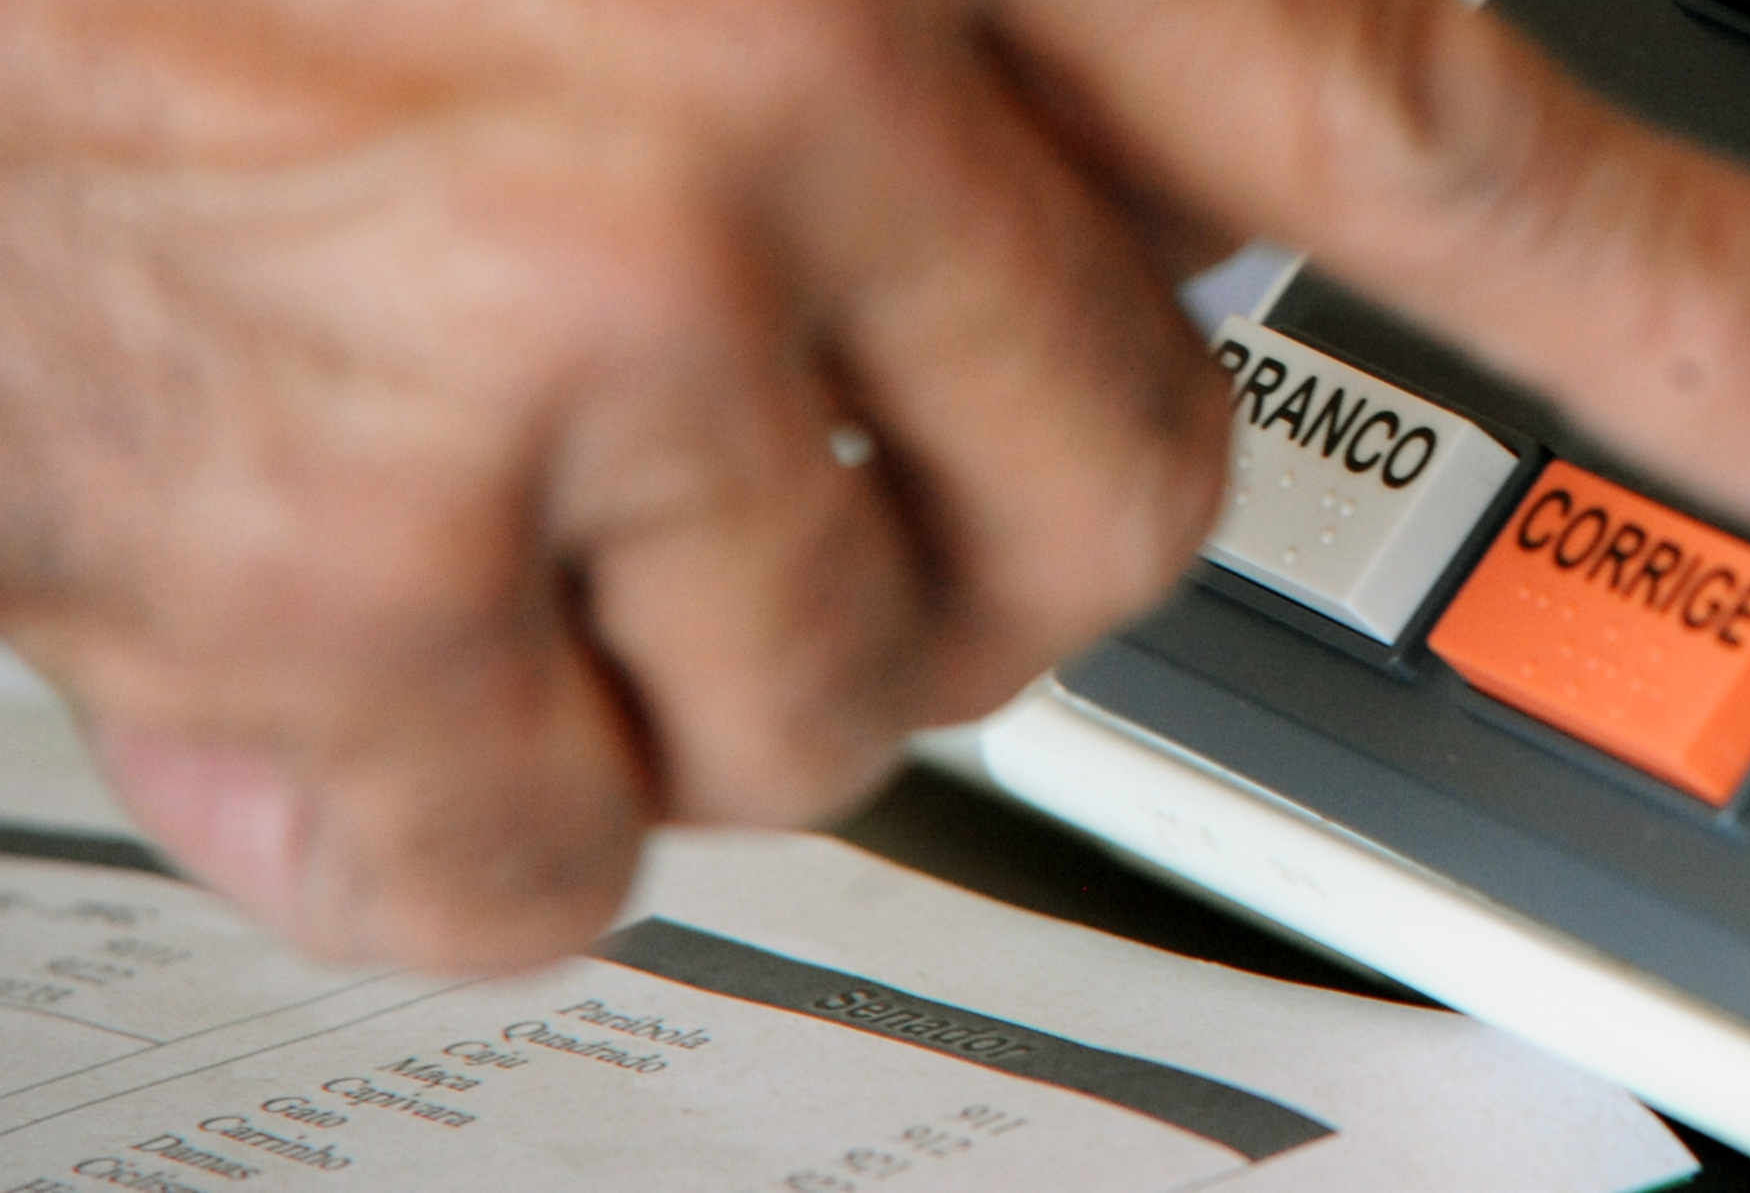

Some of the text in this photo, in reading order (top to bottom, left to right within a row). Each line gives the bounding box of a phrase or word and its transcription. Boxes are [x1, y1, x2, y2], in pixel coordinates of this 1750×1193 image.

[502, 1020, 669, 1074] Quadrado
[556, 998, 711, 1050] Parábola
[813, 988, 1036, 1058] Senador
[441, 1040, 530, 1069] Caju
[260, 1096, 348, 1129] Gato
[320, 1075, 478, 1128] Capivara
[130, 1134, 263, 1181] Damas
[197, 1115, 352, 1172] Carrinho
